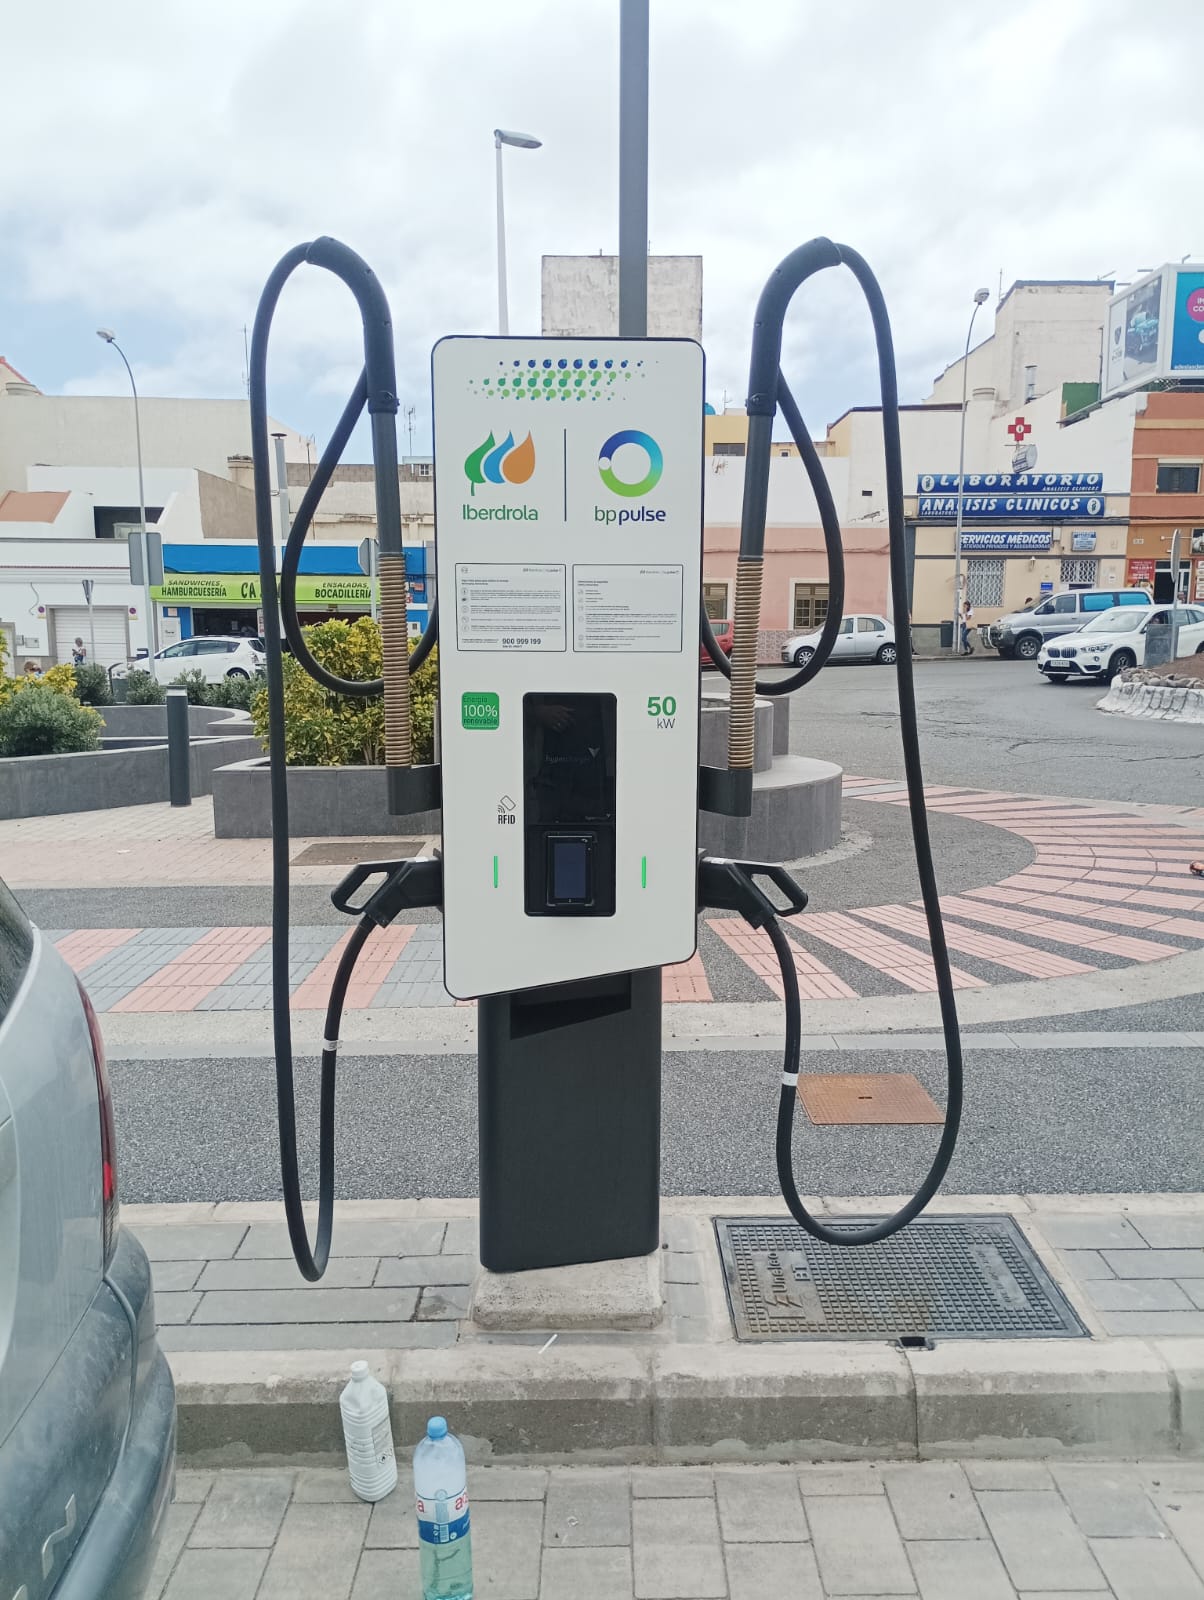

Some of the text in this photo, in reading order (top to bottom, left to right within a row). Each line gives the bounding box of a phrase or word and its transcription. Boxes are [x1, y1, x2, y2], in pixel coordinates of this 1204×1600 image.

[940, 474, 1099, 486] LABORATORIO
[1005, 498, 1080, 511] CLINICOS
[462, 504, 538, 520] Iberdrola
[960, 534, 1006, 544] SERVICIOS
[463, 704, 498, 717] 100%
[647, 696, 677, 716] 50
[656, 718, 676, 729] kW
[497, 814, 516, 825] RFID
